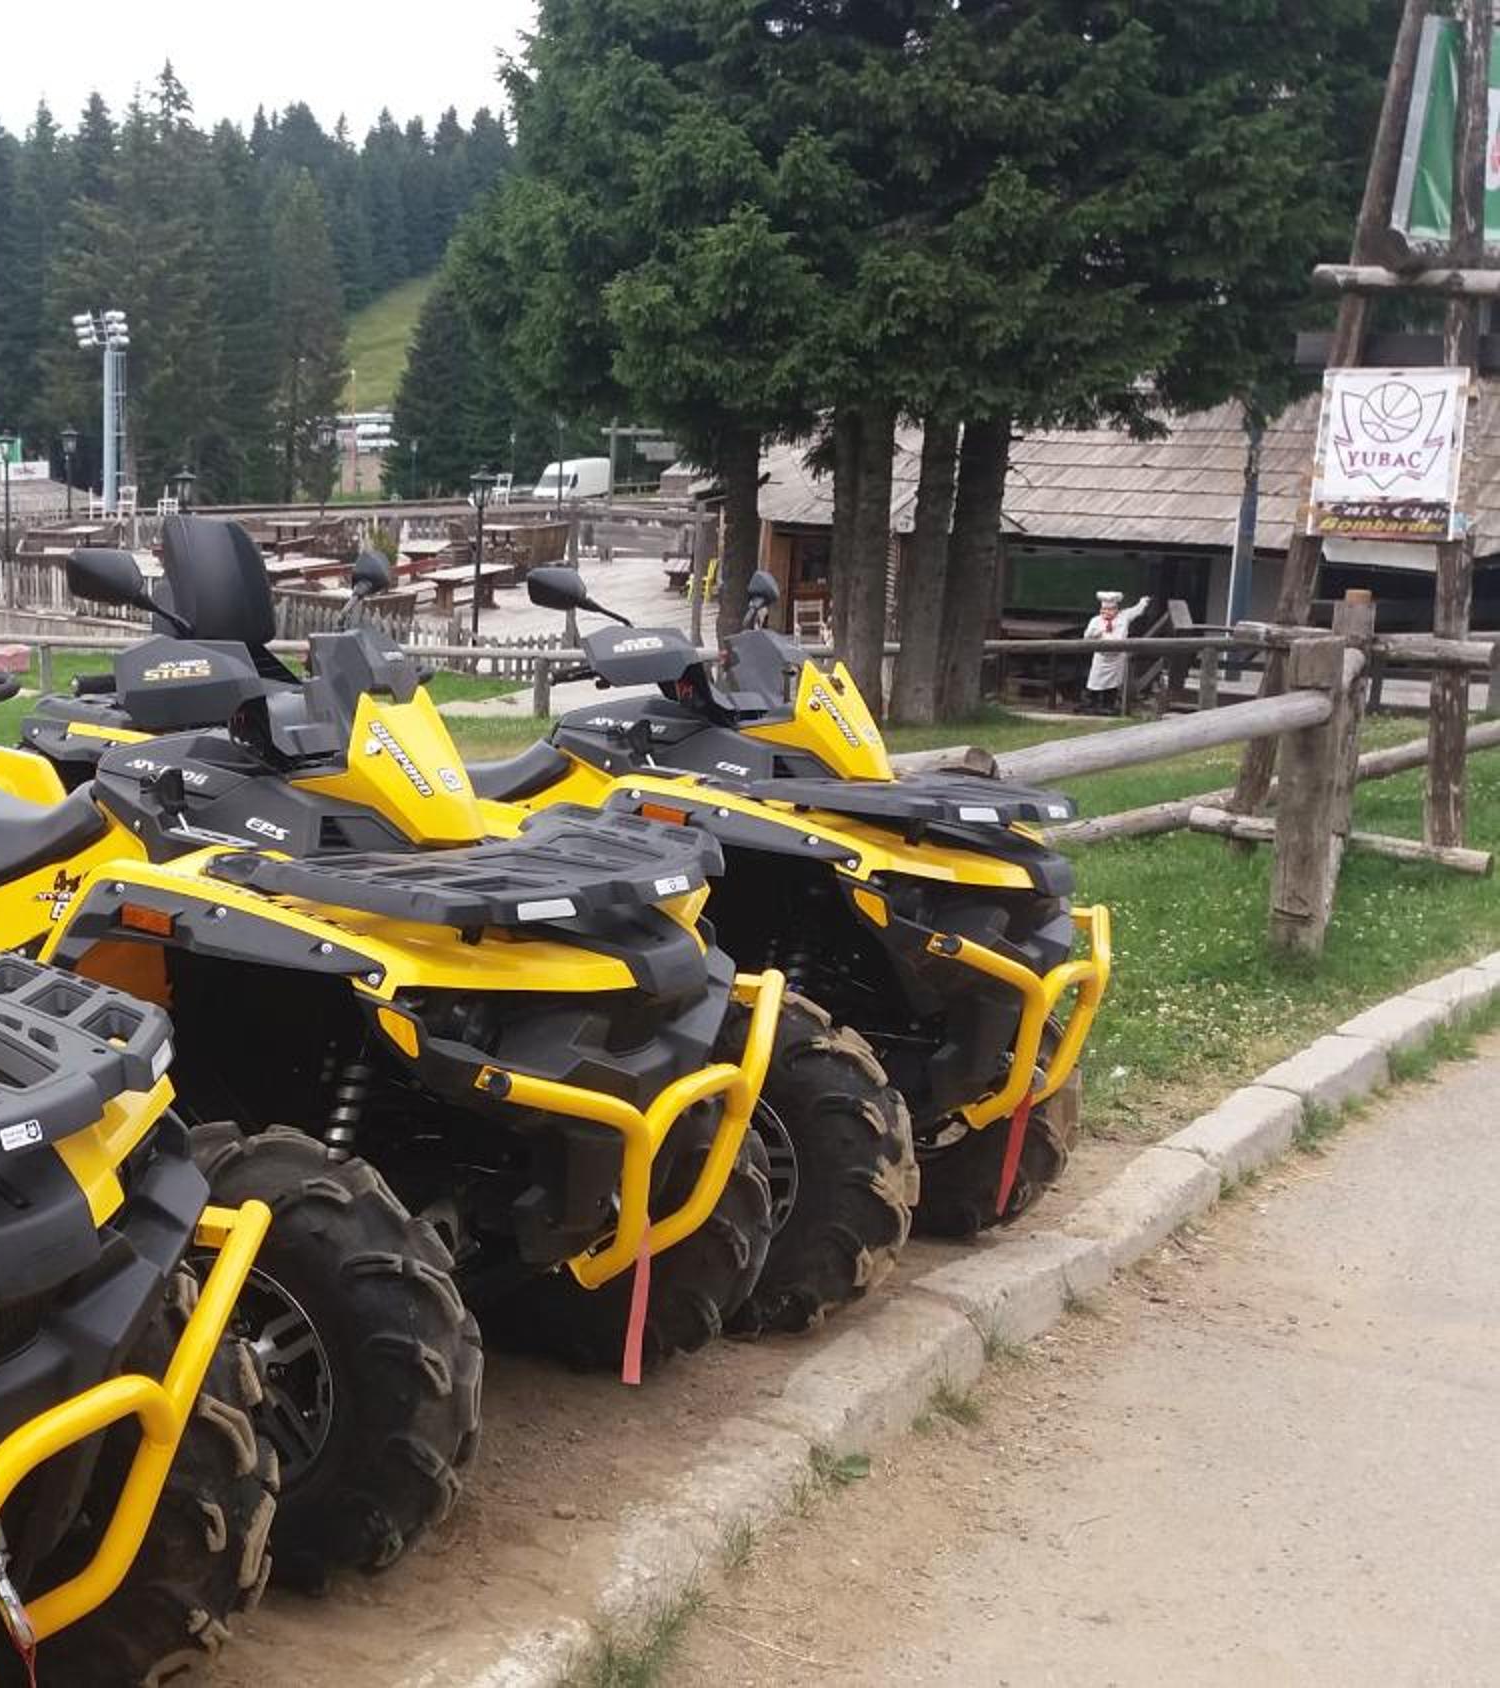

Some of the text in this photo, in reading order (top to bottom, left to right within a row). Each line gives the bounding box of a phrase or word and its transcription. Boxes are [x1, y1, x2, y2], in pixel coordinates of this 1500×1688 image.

[1348, 451, 1423, 469] YUBAC
[368, 720, 434, 797] GUEPARD
[245, 817, 291, 841] EPS
